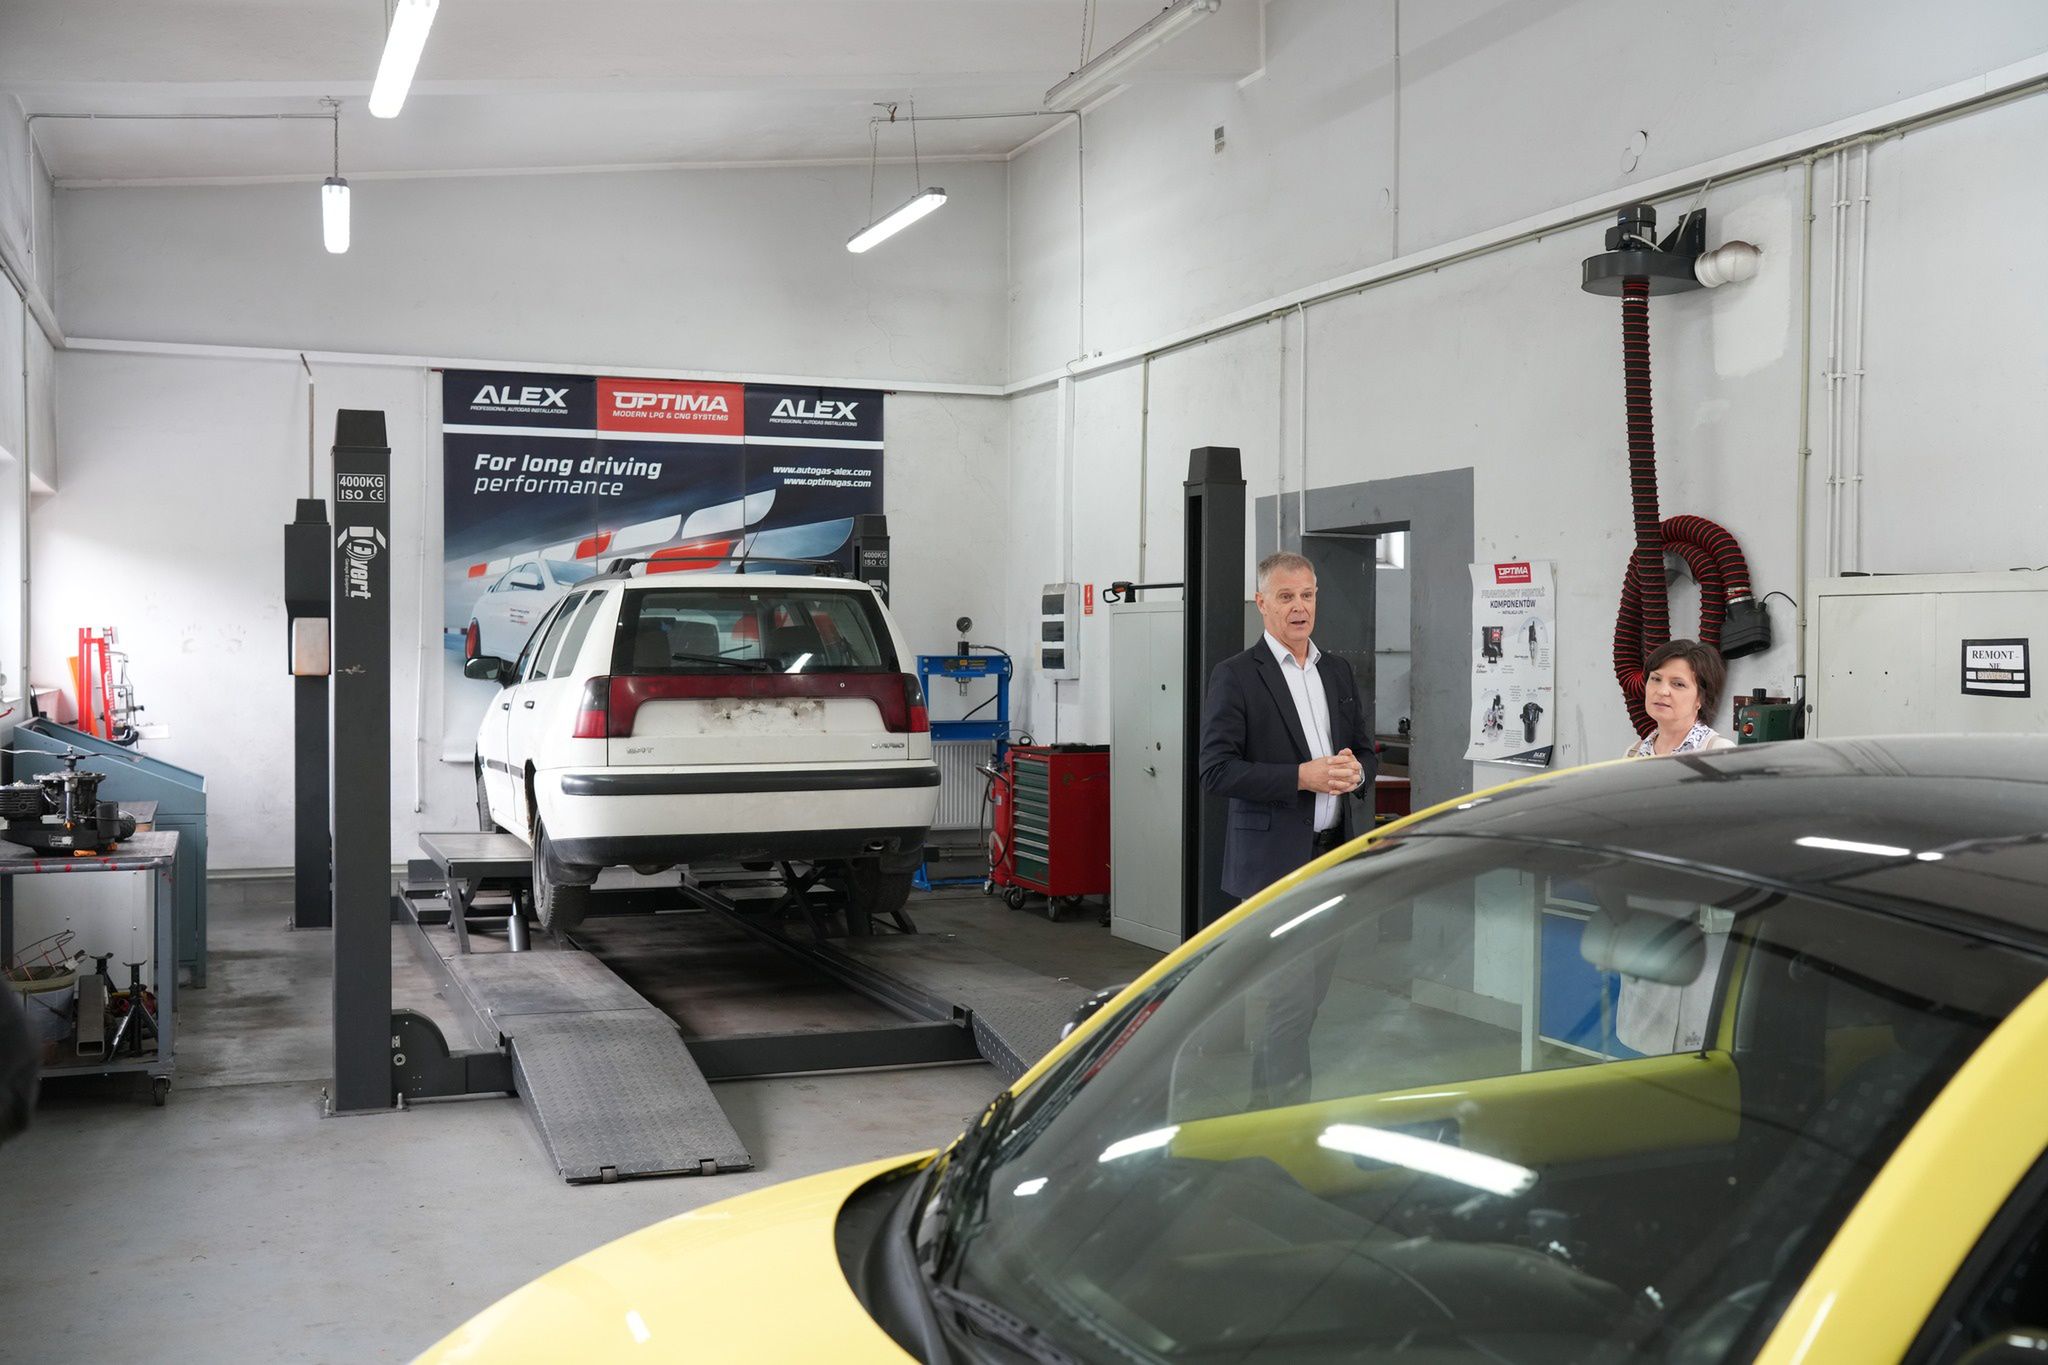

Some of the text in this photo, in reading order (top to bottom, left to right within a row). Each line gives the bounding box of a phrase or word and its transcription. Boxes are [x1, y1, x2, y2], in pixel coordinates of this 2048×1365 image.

[472, 385, 570, 407] ALEX
[612, 391, 729, 412] OPTIMA
[612, 410, 647, 418] MODERN
[648, 411, 664, 419] LPG
[674, 412, 690, 420] CNG
[692, 413, 729, 421] SYSTEMS
[771, 399, 859, 420] ALEX
[474, 453, 662, 480] For long driving
[772, 466, 872, 477] www.autogas-alex.com
[339, 476, 384, 488] 4000KG
[473, 475, 624, 496] performance
[783, 477, 872, 488] www.optimagas.com
[341, 489, 364, 500] ISO
[1497, 566, 1529, 576] OPTIMA
[1489, 597, 1537, 609] KOMPONENTÓW
[1972, 650, 2014, 660] REMONT
